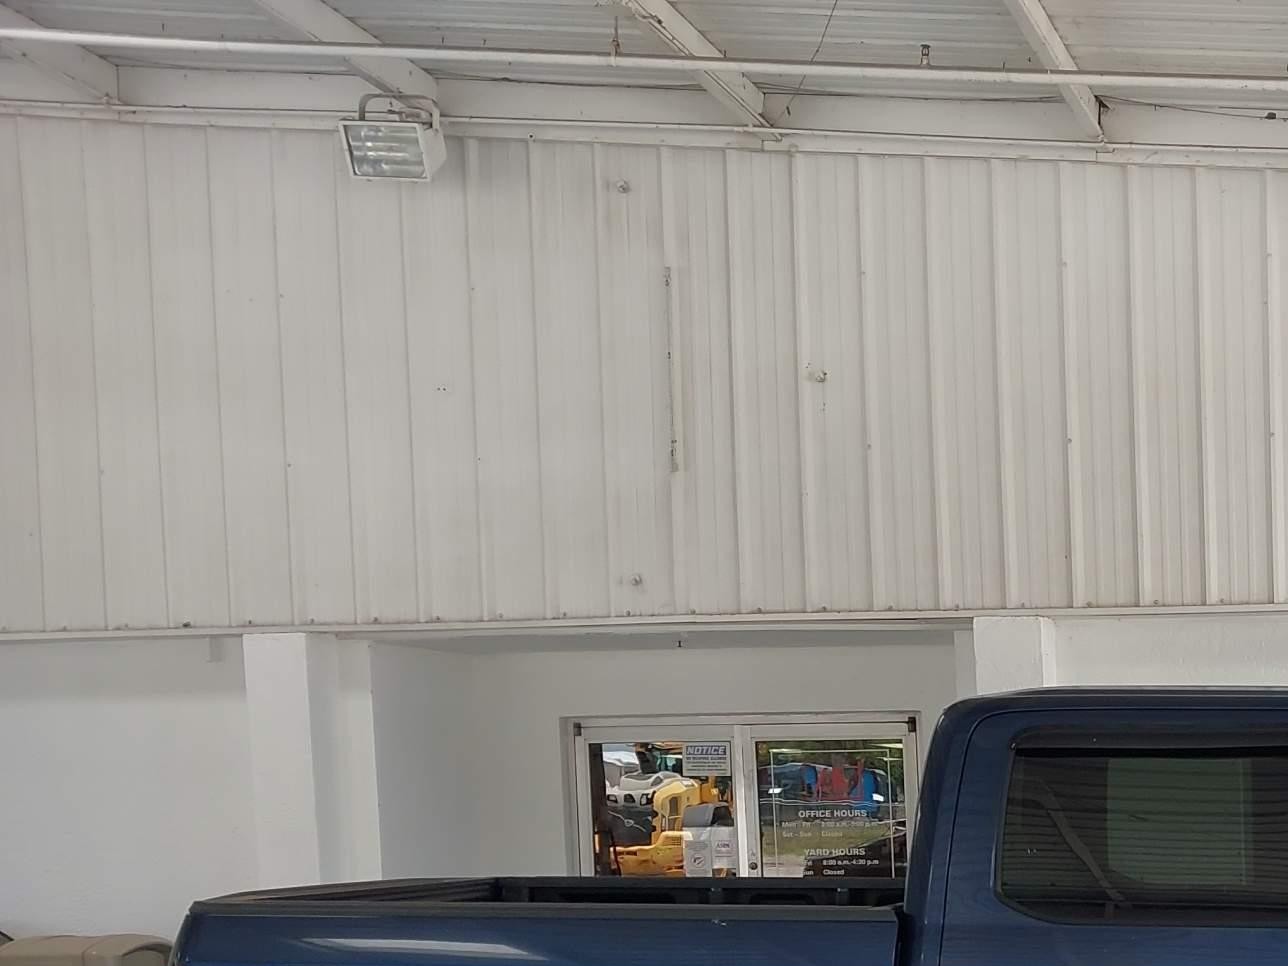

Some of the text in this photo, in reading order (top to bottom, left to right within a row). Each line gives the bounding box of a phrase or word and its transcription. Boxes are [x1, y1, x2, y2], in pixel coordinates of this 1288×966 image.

[687, 746, 725, 755] NOTICE
[798, 809, 868, 818] OFFICE HOURS
[804, 848, 866, 857] YARD HOURS
